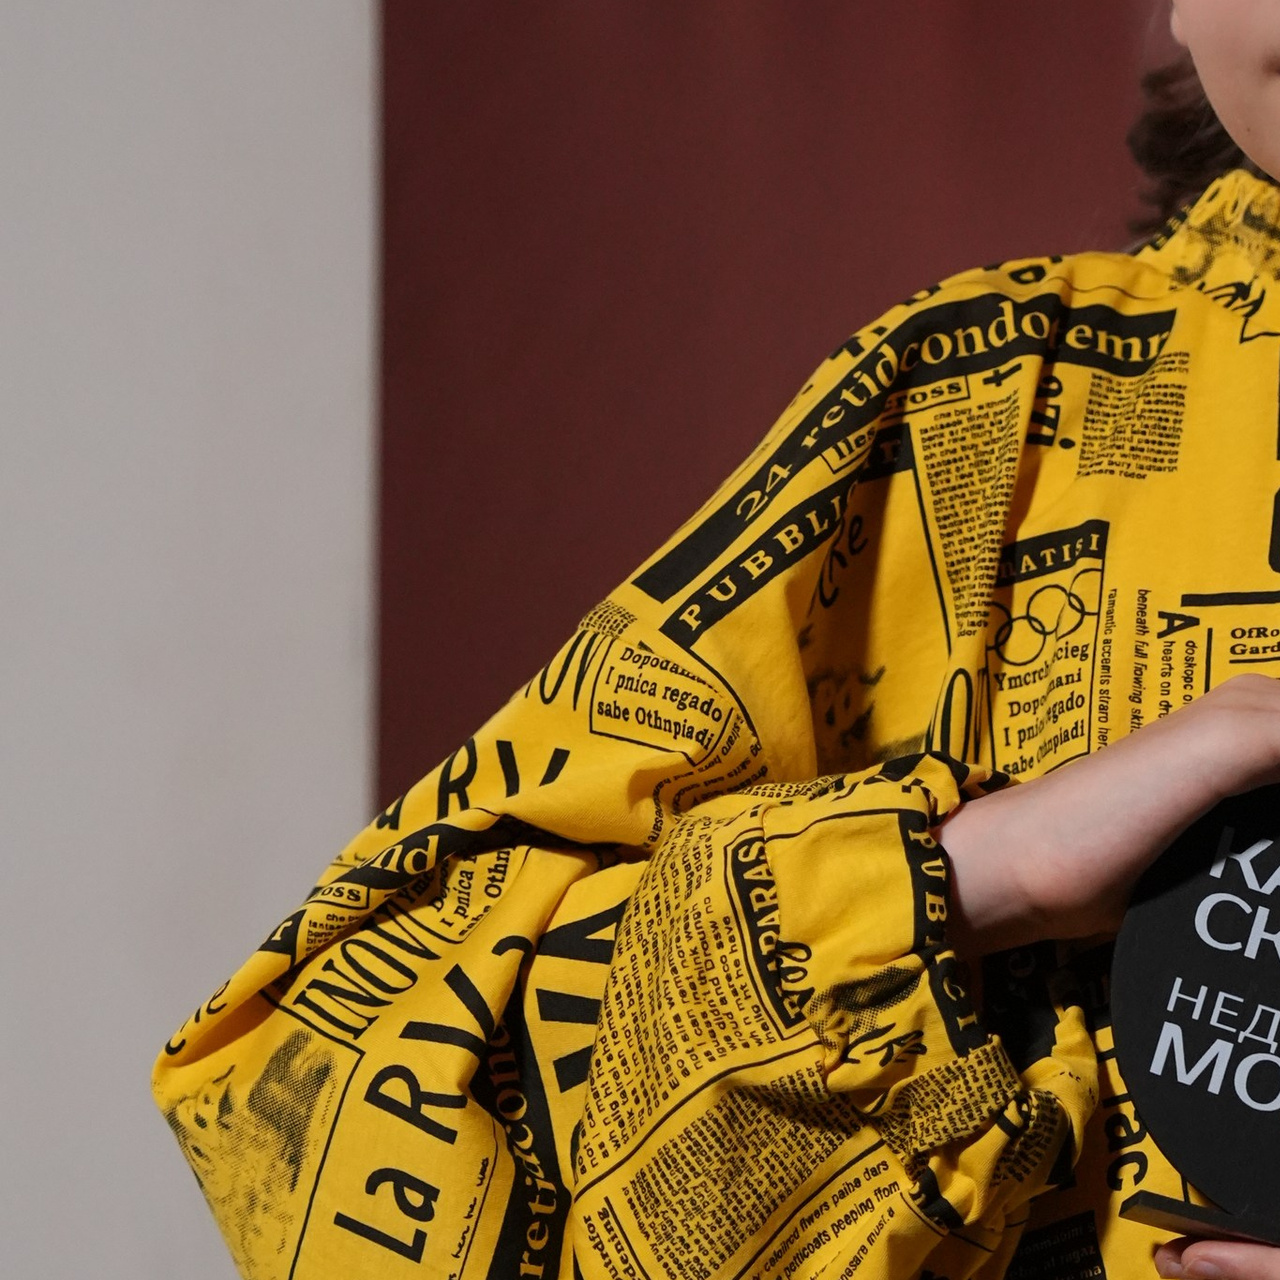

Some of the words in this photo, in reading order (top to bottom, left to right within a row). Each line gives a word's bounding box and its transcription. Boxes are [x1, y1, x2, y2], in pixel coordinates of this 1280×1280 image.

[735, 461, 793, 522] 24
[597, 700, 630, 722] sabe
[614, 672, 658, 697] pnica
[661, 685, 724, 724] regado
[831, 1198, 874, 1238] peeping
